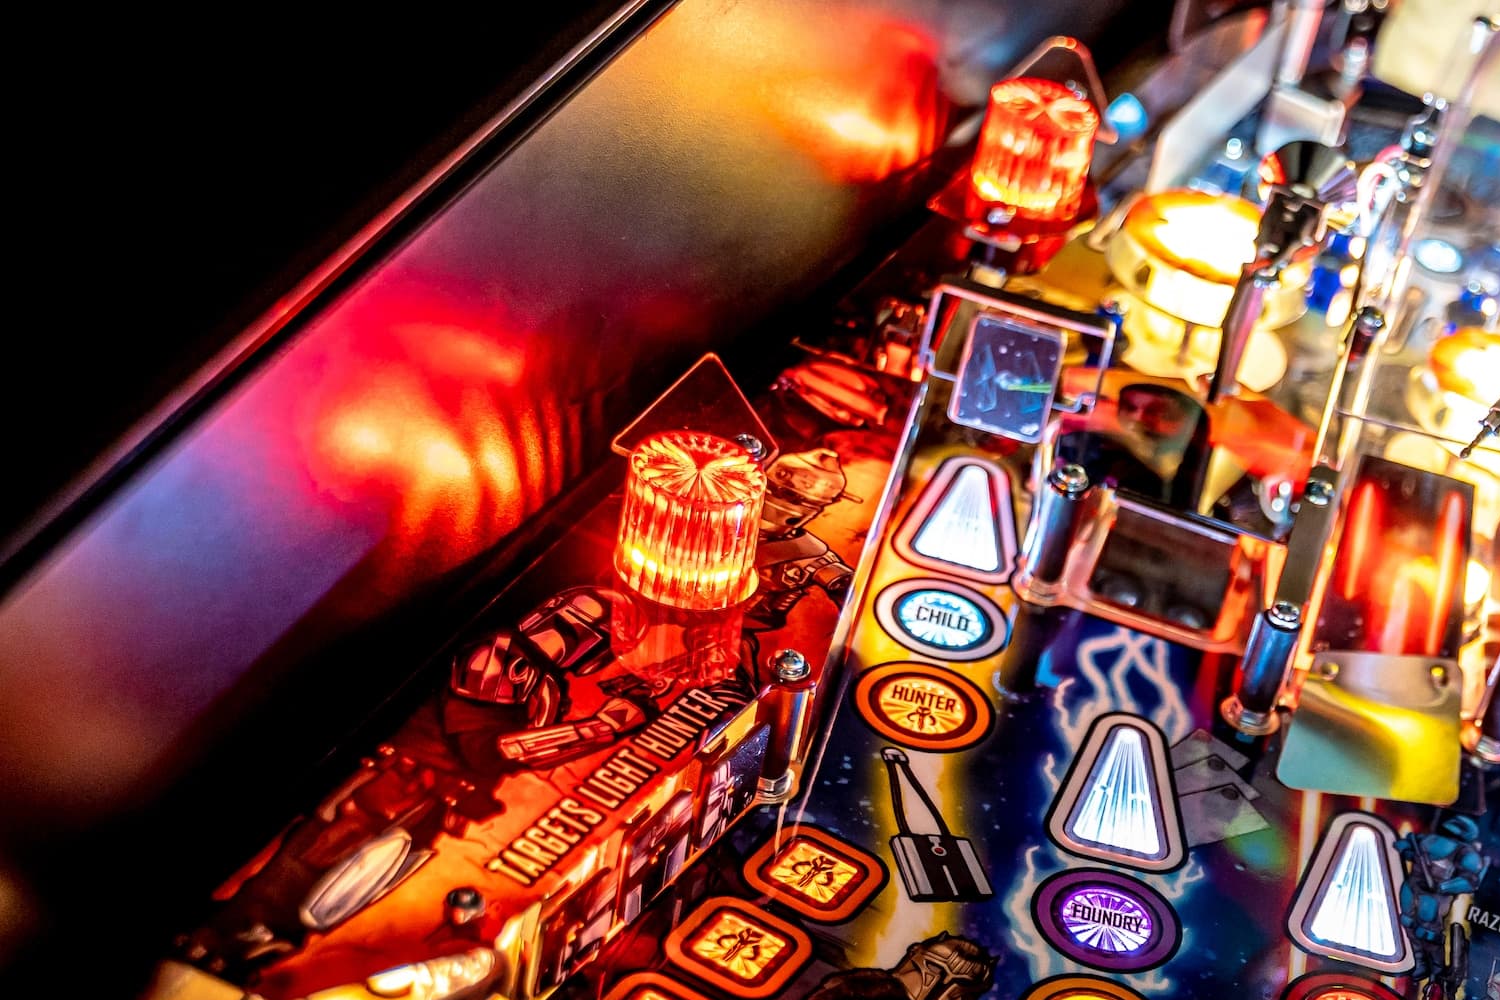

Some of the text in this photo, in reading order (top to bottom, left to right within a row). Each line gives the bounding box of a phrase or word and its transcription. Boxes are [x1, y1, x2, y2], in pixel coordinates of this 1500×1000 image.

[916, 606, 970, 631] CHILD
[891, 685, 956, 713] HUNTER
[489, 688, 728, 885] TARGETS LIGHT HUNTER
[1071, 902, 1143, 934] FOUNDRY
